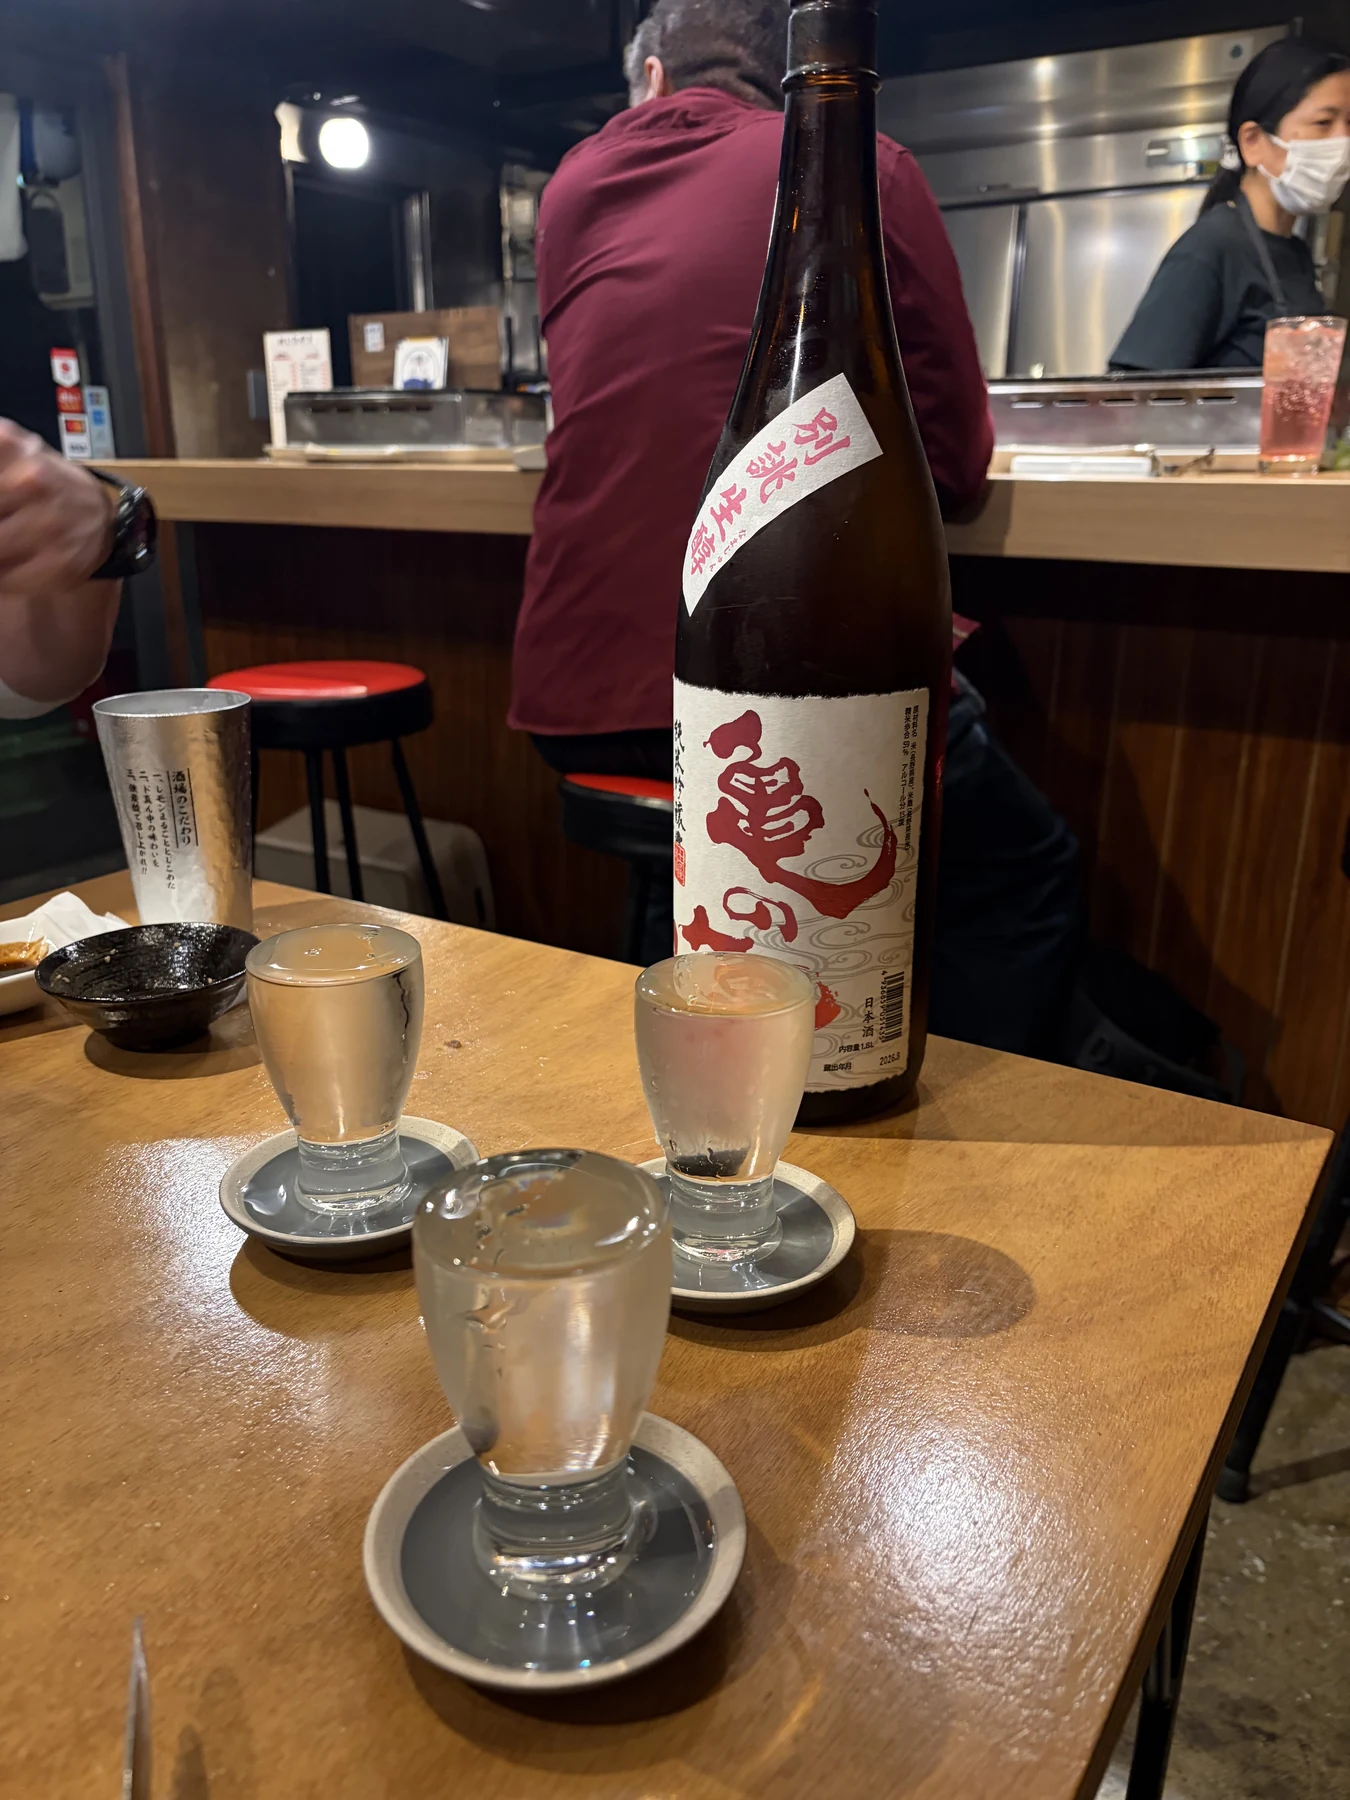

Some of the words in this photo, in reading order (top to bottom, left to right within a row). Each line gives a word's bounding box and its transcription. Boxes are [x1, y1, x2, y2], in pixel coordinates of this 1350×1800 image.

[691, 407, 850, 575] 別誂生醇
[709, 529, 747, 572] なまじゅん
[139, 771, 160, 868] 二、ド真ん中の味わいを
[152, 773, 176, 890] 一、レモンまるごととじこめた
[172, 771, 192, 846] 酒場のこだわり
[862, 997, 875, 1038] 日本酒
[823, 1062, 852, 1072] 蔵出年月
